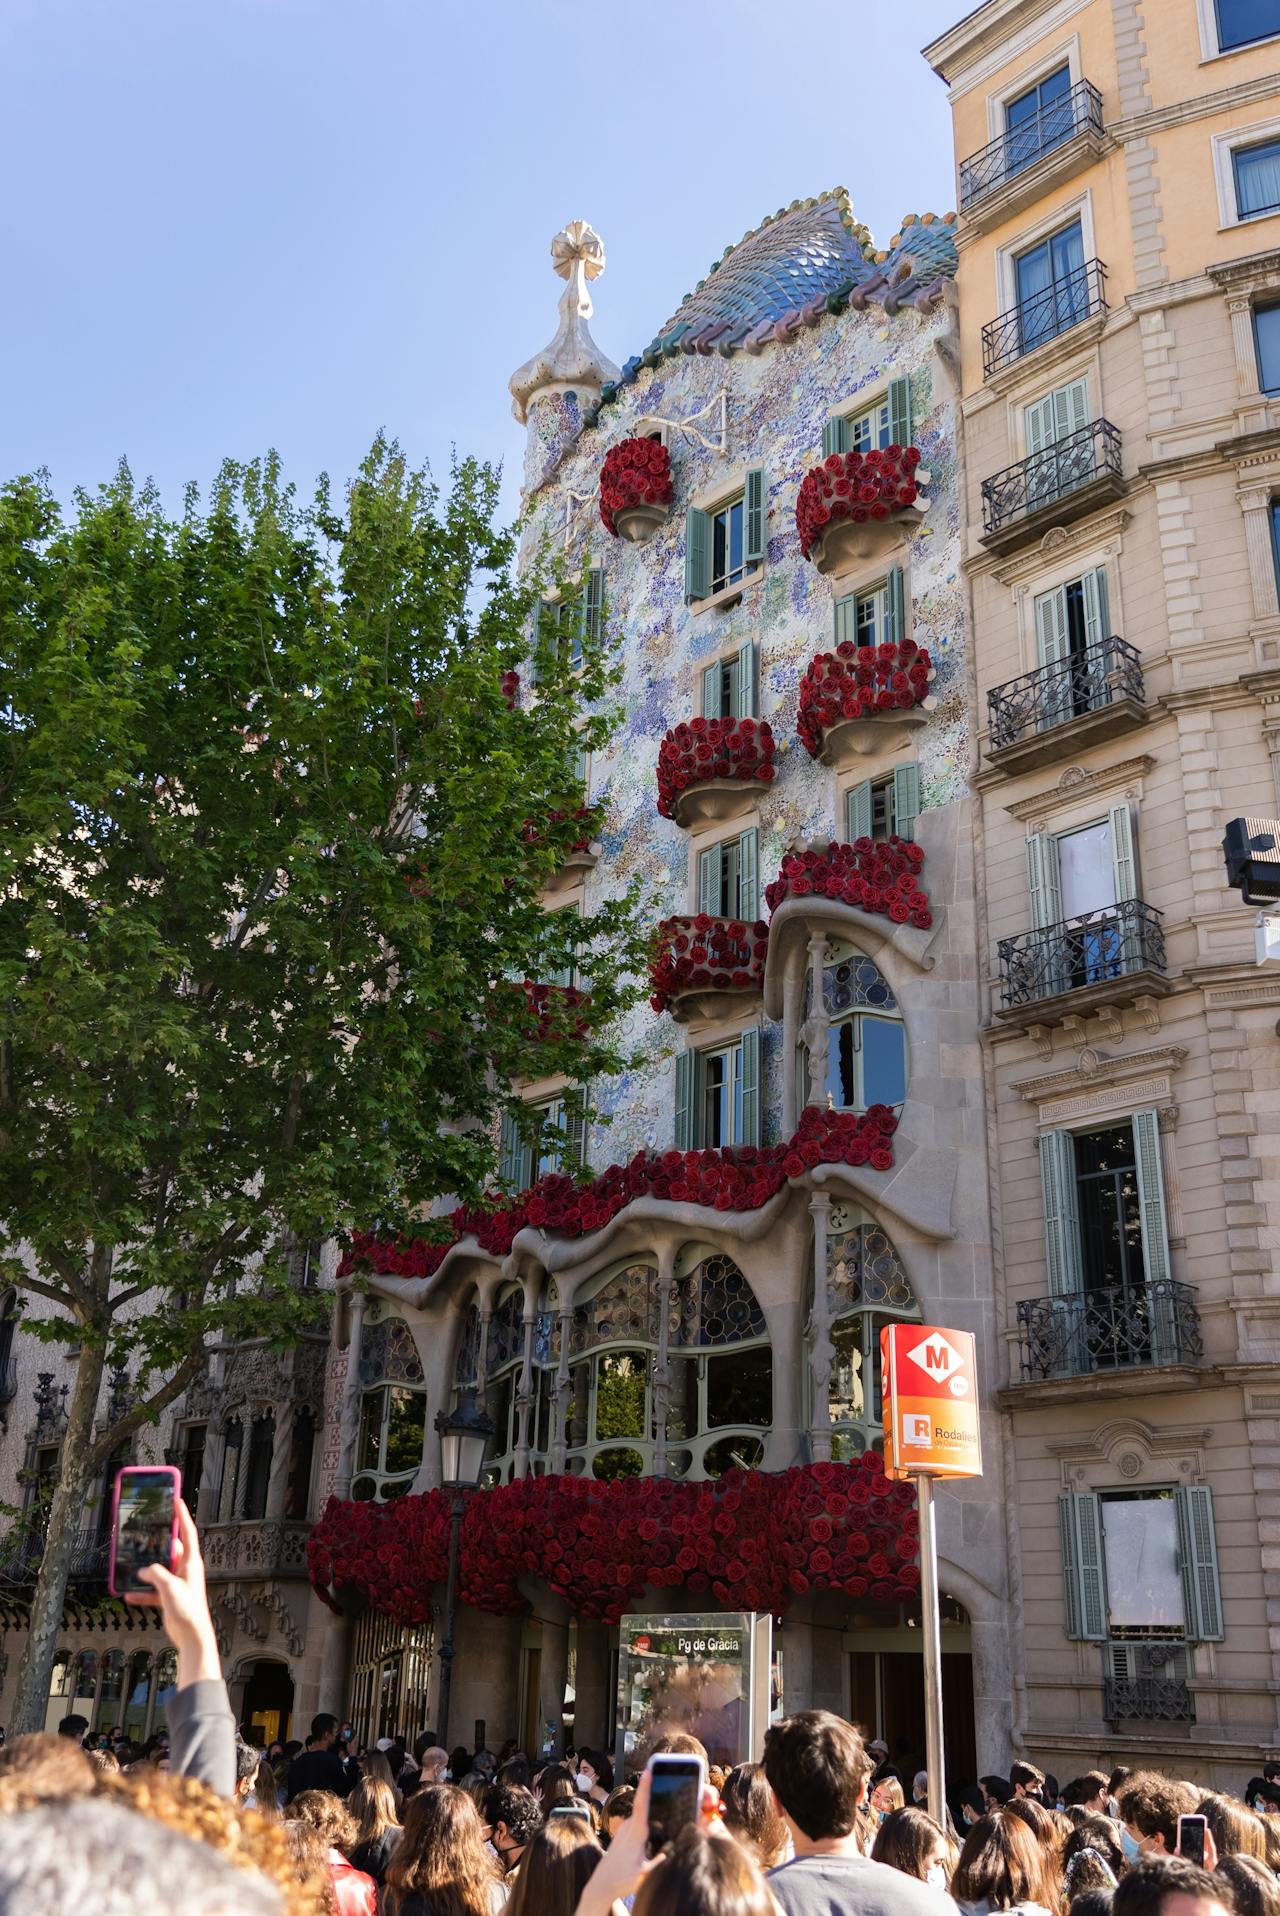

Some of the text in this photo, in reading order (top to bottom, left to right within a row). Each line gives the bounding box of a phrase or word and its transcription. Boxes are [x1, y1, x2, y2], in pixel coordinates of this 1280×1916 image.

[926, 1345, 949, 1370] M
[914, 1419, 929, 1437] R
[935, 1427, 977, 1443] Rodalies
[678, 1637, 739, 1653] Pg de Gràcia
